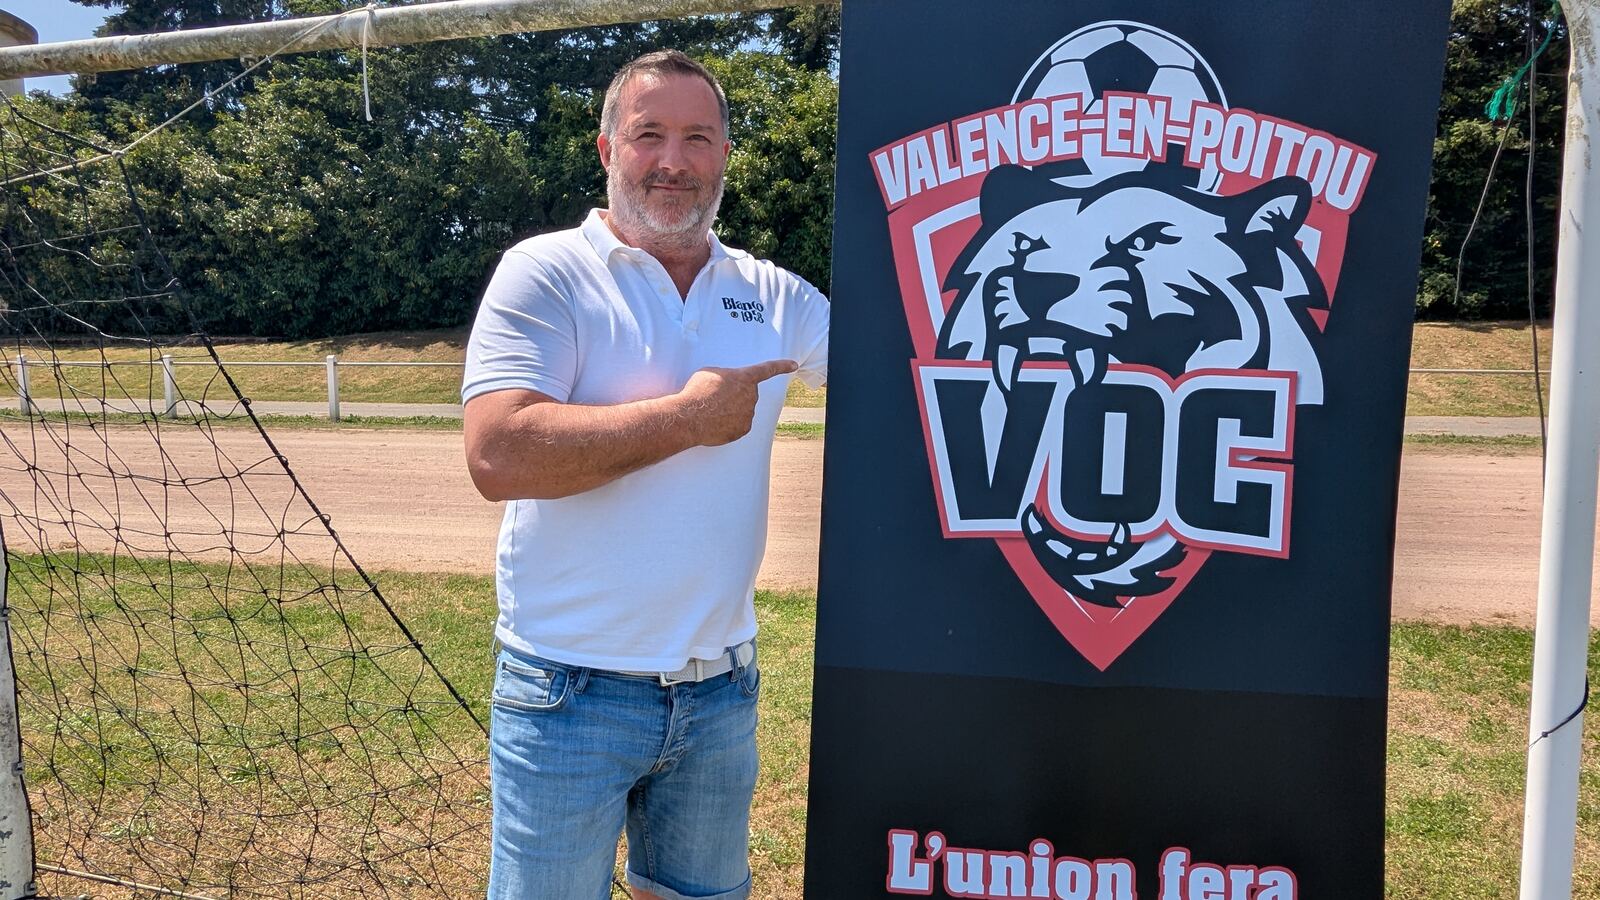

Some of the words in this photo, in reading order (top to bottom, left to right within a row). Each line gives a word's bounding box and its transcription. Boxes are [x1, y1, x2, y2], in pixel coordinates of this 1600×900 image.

[874, 95, 1371, 210] VALENCE-EN-POITOU
[721, 297, 764, 312] Blanco
[741, 310, 764, 324] 1958
[922, 368, 1288, 548] VOC
[889, 832, 1133, 900] L'union
[1162, 850, 1295, 900] fera
